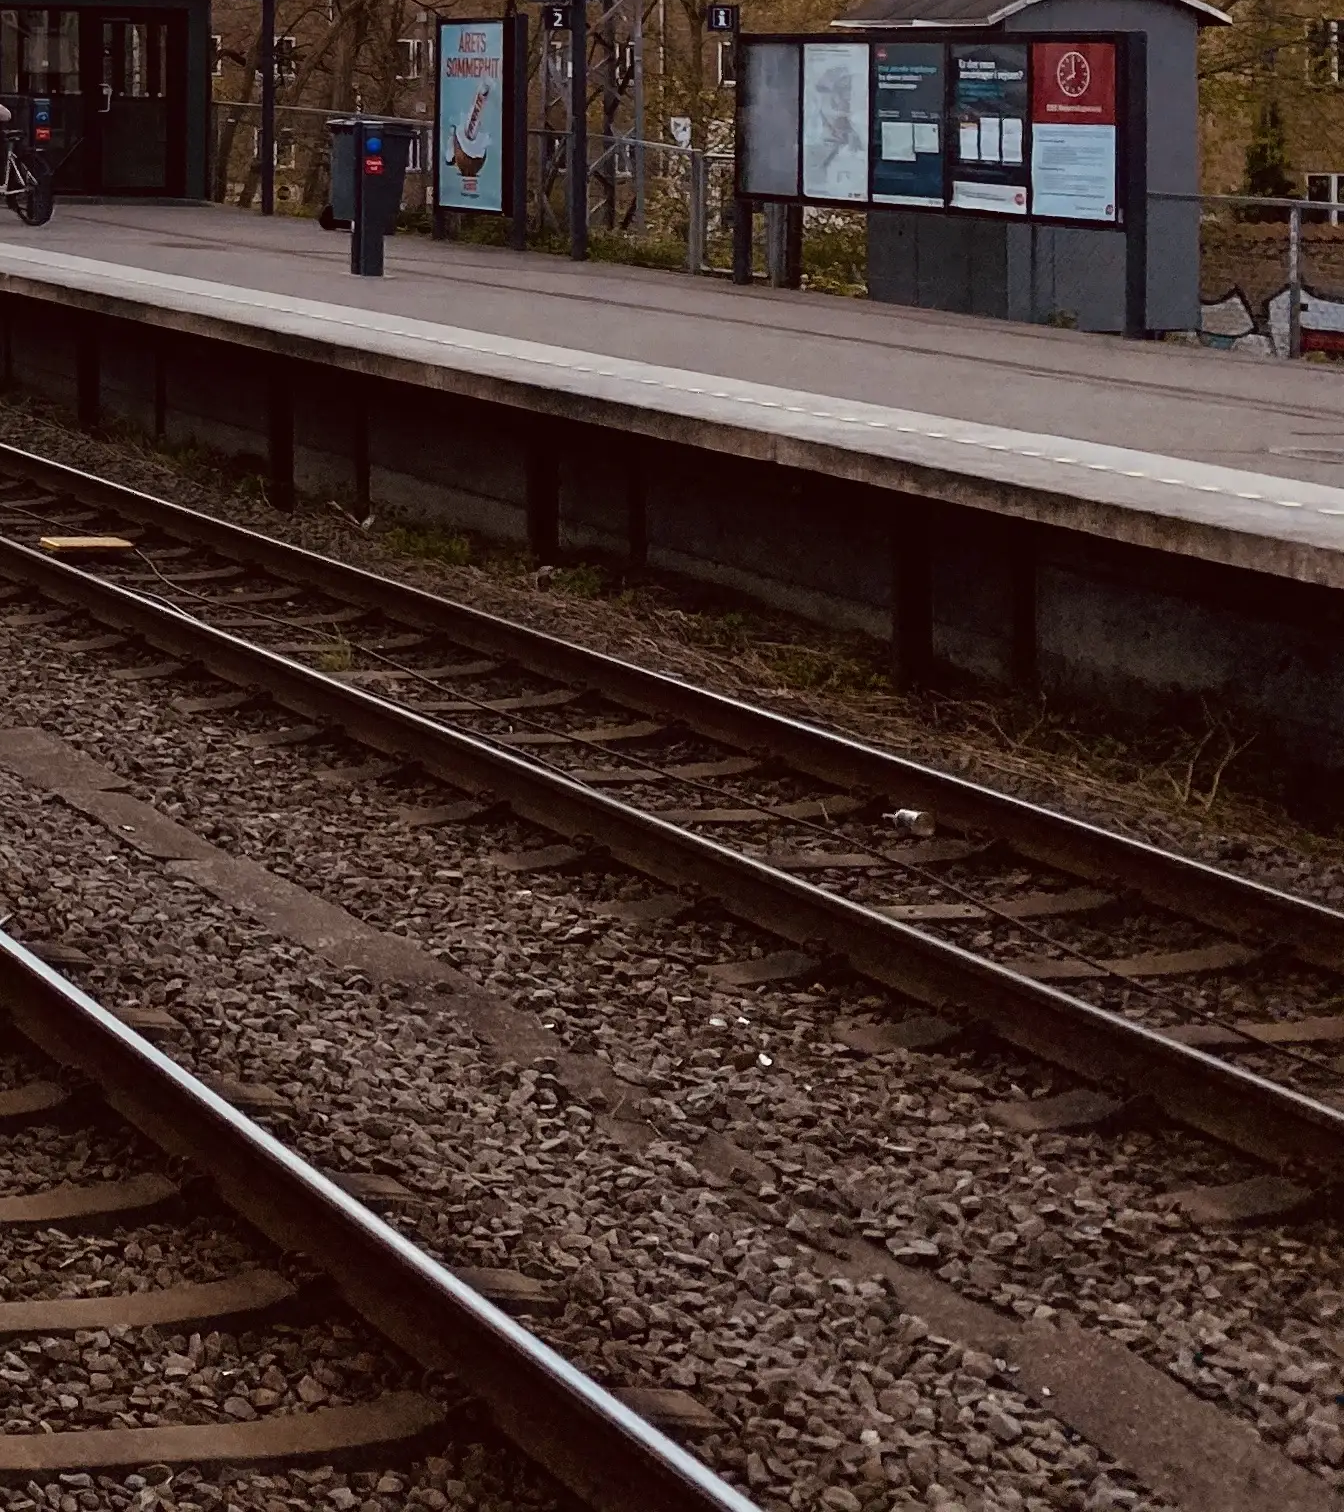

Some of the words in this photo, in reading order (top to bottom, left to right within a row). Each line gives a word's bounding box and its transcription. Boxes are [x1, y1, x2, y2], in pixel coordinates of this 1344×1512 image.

[553, 12, 563, 27] 2
[458, 30, 486, 53] ÅRETS
[446, 58, 500, 78] SOMMERHIT
